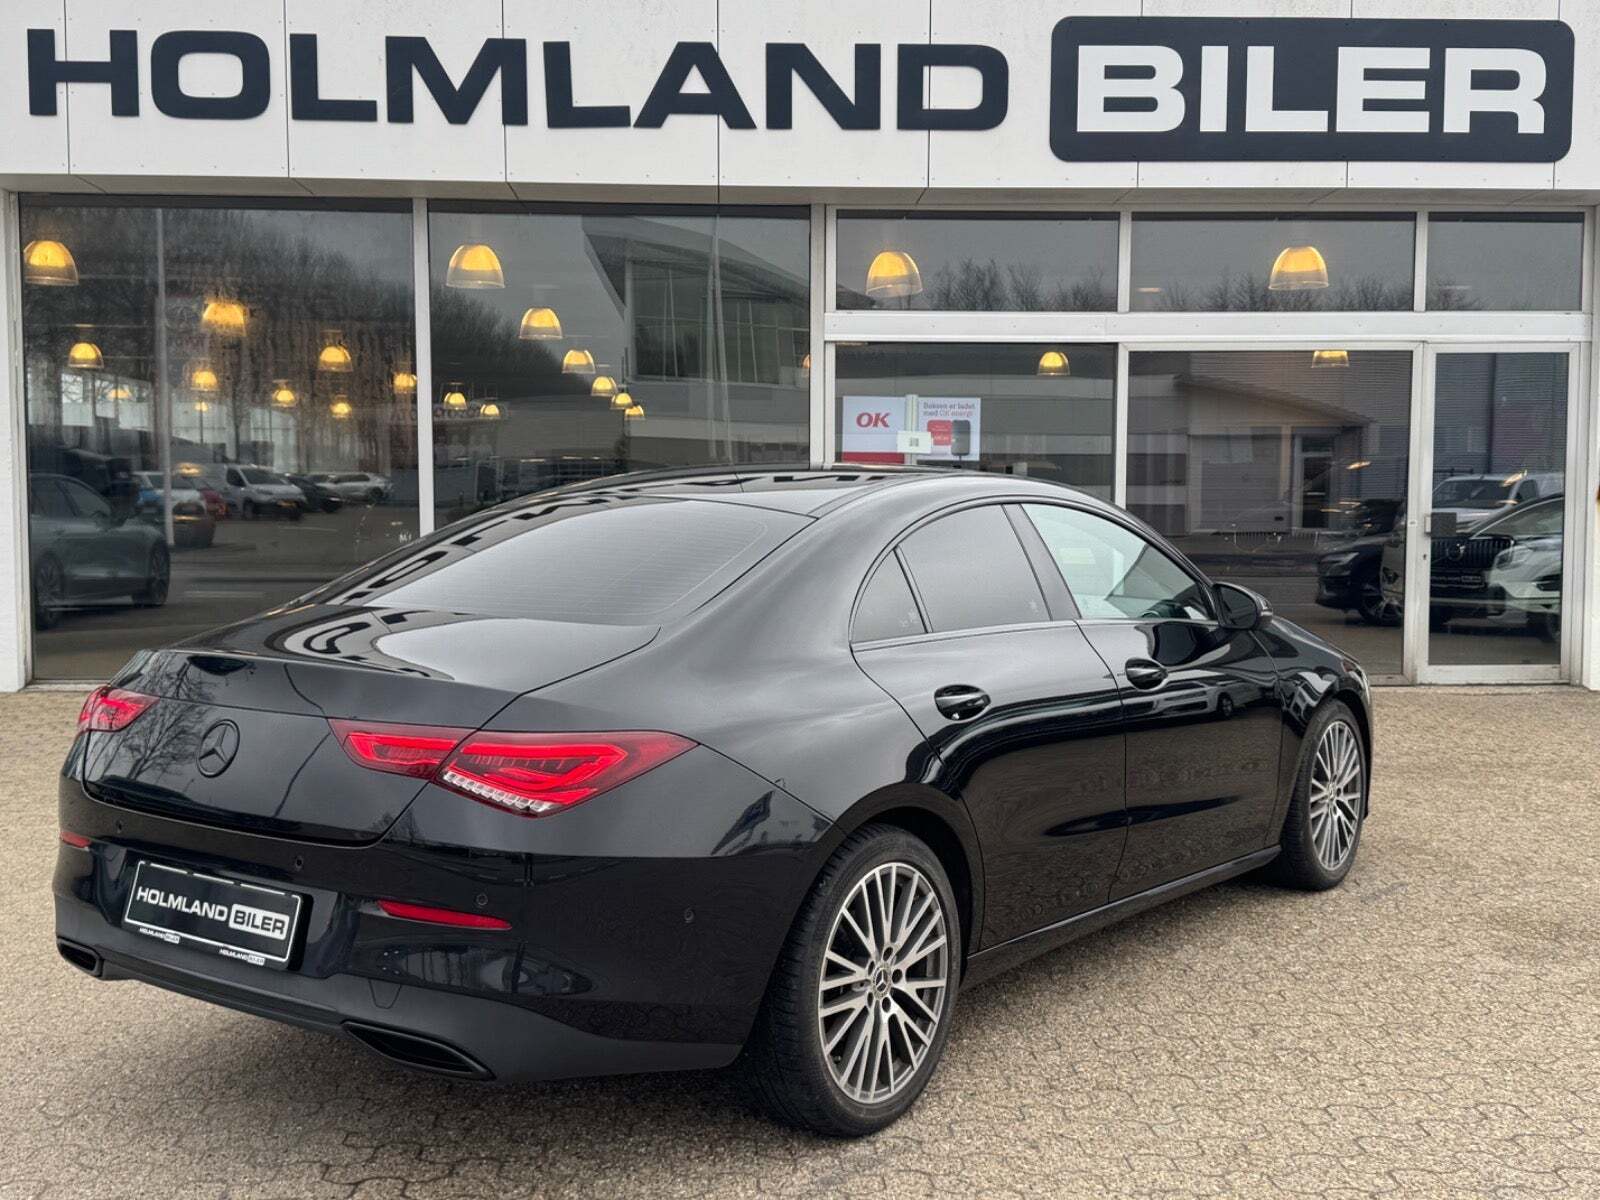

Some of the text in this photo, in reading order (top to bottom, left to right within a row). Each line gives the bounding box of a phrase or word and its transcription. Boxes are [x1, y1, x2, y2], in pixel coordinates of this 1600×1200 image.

[28, 28, 1547, 135] HOLMLAND BILER
[856, 412, 890, 428] OK
[136, 886, 286, 935] HOLMLAND BILER
